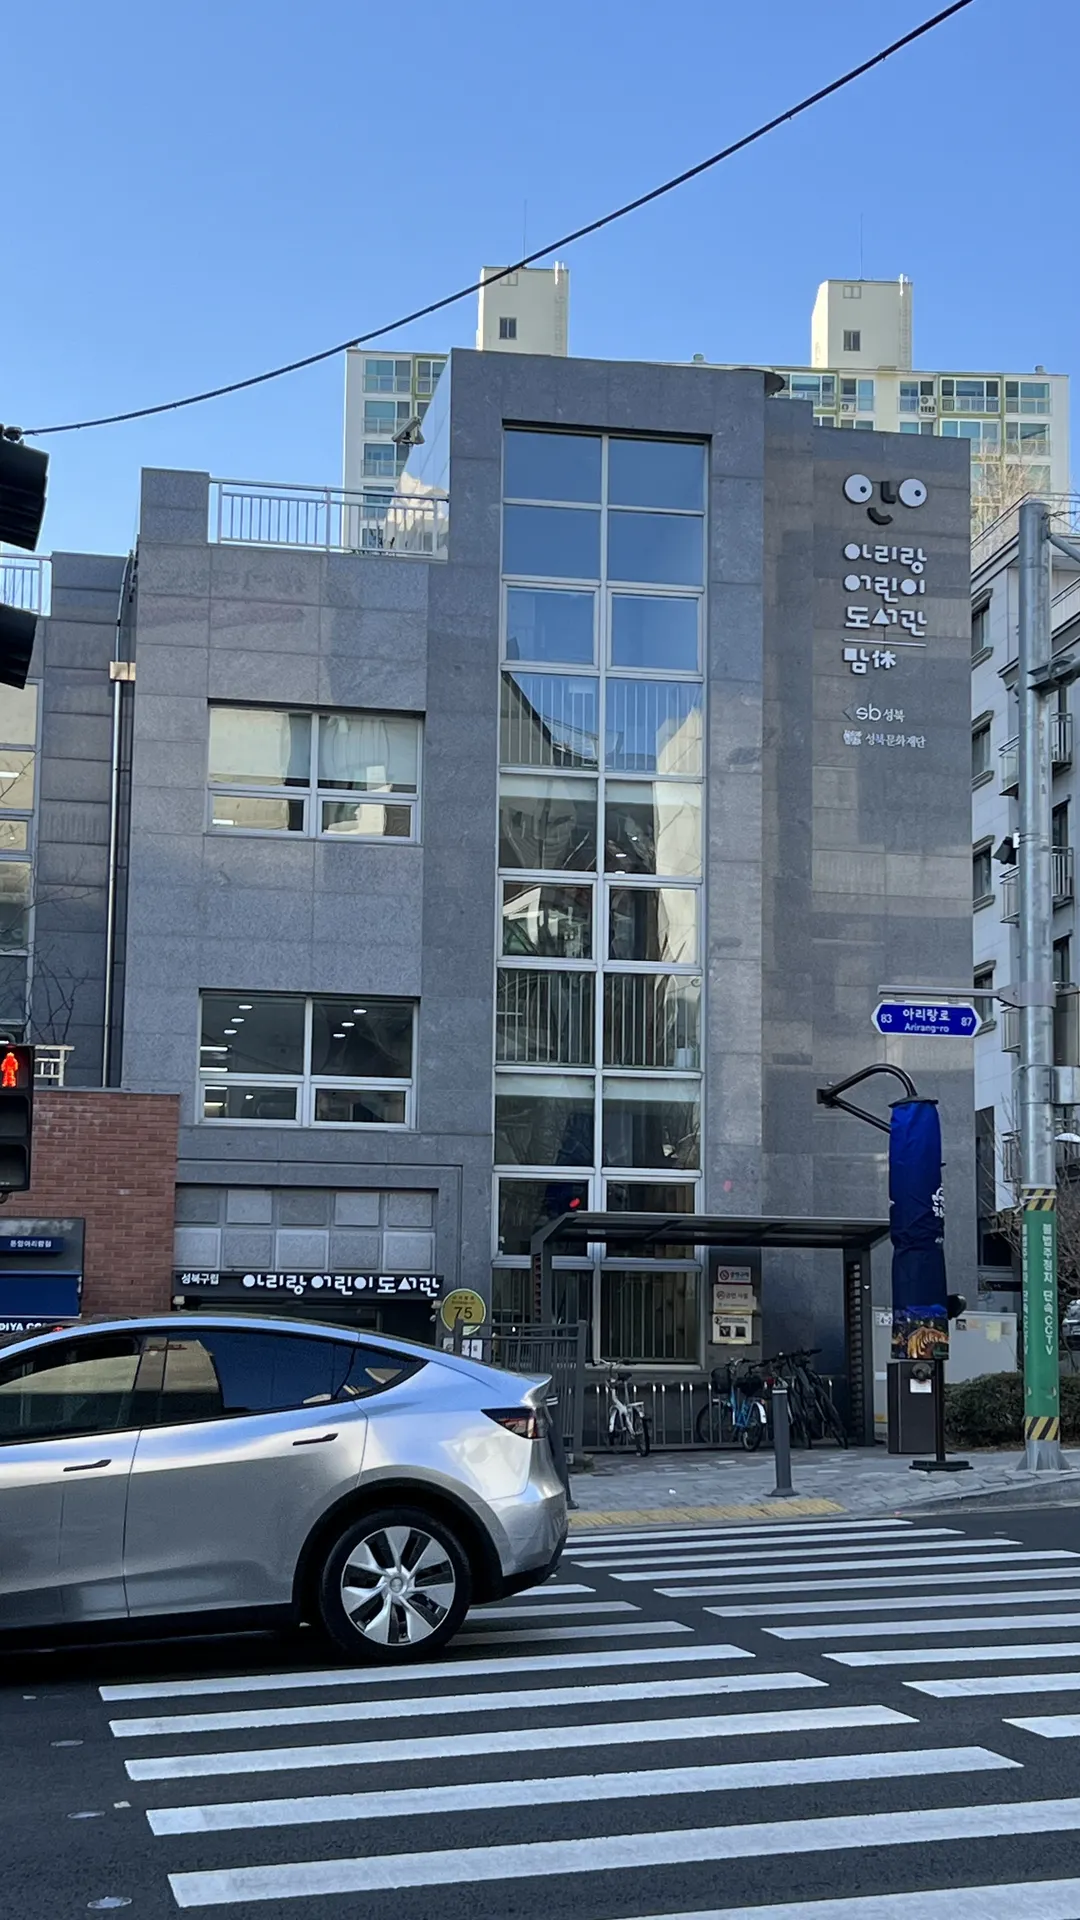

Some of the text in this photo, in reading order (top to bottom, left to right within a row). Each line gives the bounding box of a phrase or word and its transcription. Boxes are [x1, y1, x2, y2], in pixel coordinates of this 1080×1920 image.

[844, 543, 927, 574] 아리랑
[844, 574, 925, 603] 어린이
[845, 606, 927, 636] 도서관
[865, 733, 926, 749] 성북문화재단
[880, 1007, 973, 1026] 83 아리랑로 87
[904, 1022, 950, 1034] Arirang-ro
[181, 1273, 440, 1297] 성북구립 아리랑 어린이 도서관
[454, 1306, 473, 1319] 75
